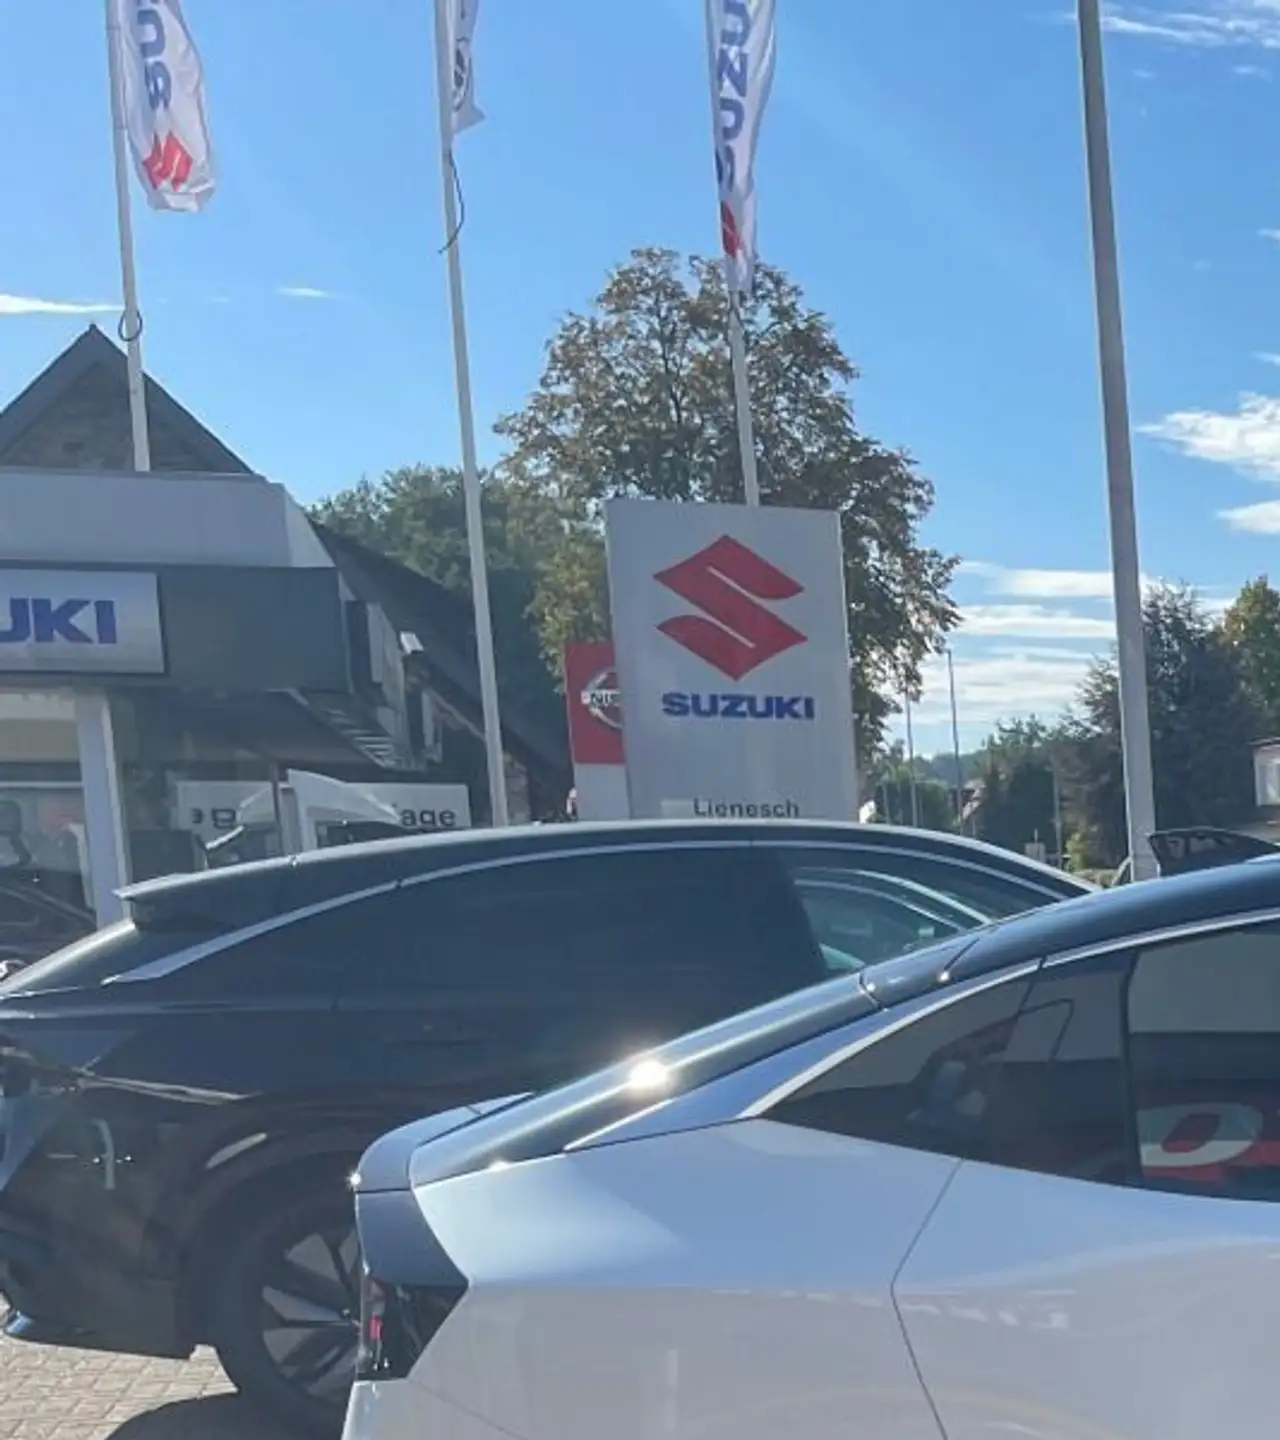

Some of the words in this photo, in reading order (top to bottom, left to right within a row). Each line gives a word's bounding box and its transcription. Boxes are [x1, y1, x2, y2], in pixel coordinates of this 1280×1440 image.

[136, 0, 172, 110] SU
[662, 692, 815, 720] SUZUKI
[693, 798, 799, 818] Lienesch
